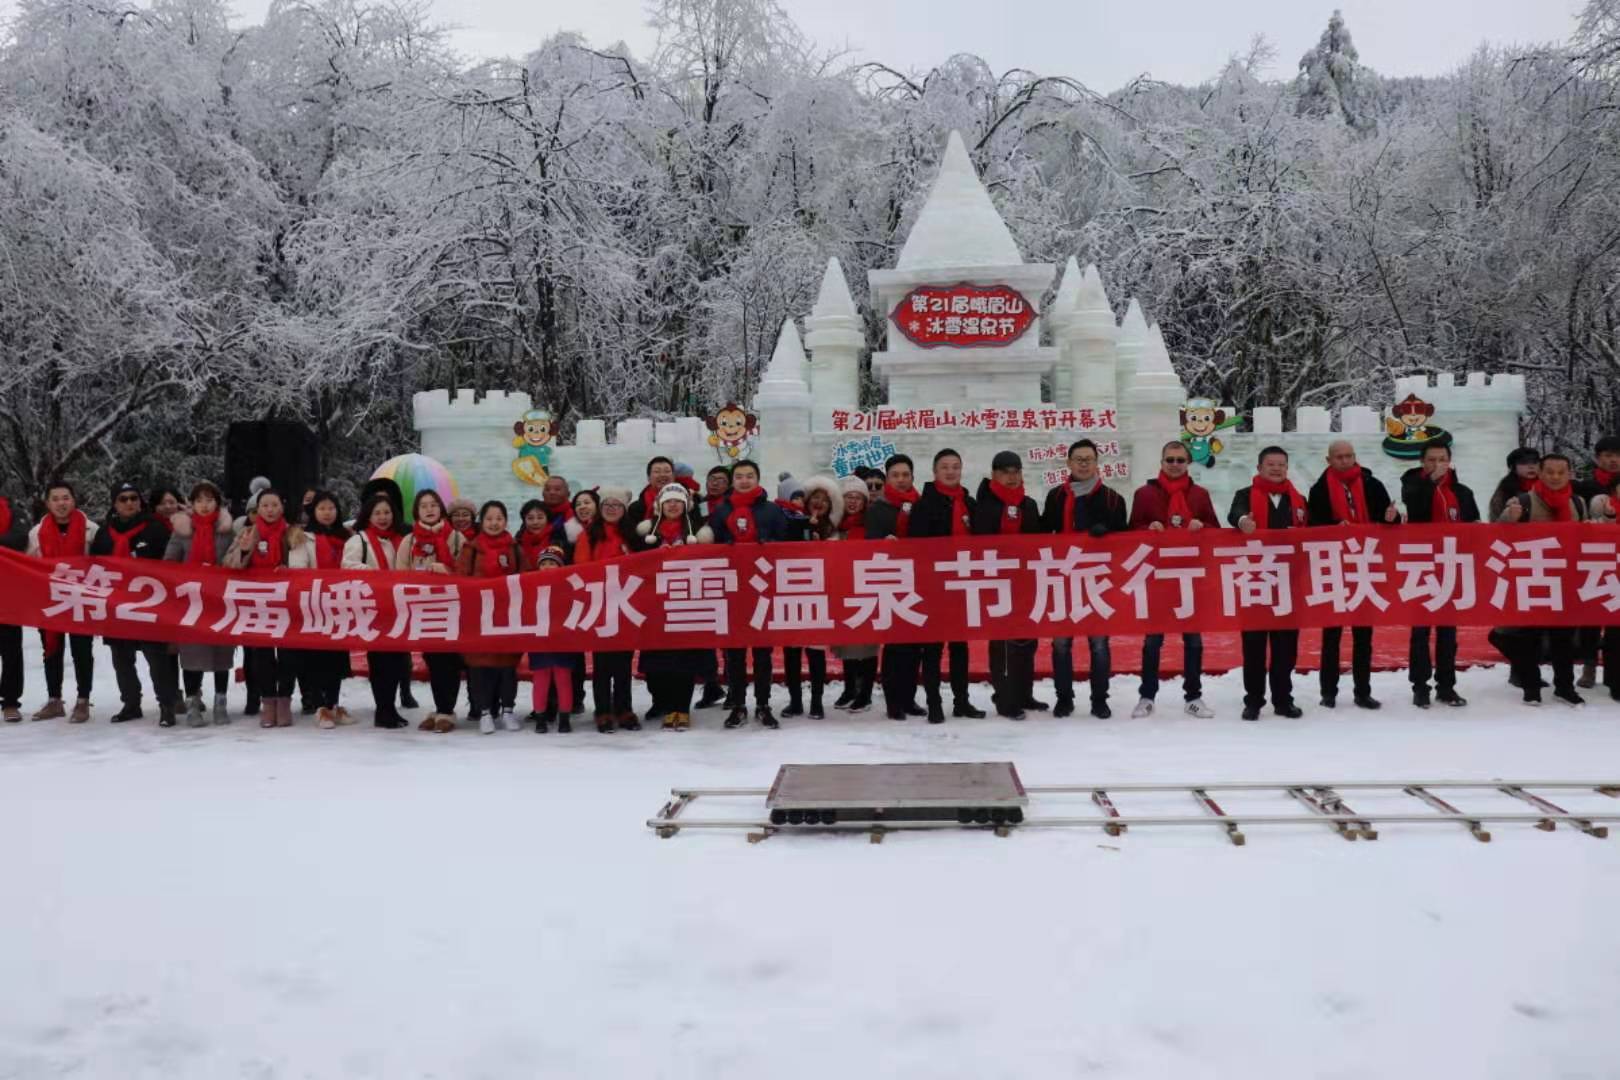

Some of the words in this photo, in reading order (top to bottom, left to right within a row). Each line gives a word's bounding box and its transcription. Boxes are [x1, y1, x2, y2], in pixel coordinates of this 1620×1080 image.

[912, 295, 1022, 314] 第21届峨眉山
[927, 316, 1015, 335] 冰雪温泉节
[832, 409, 1116, 431] 第21届峨眉山冰雪温泉节开幕式
[42, 535, 1620, 641] 第21届峨眉山冰雪温泉节旅行商联动活动
